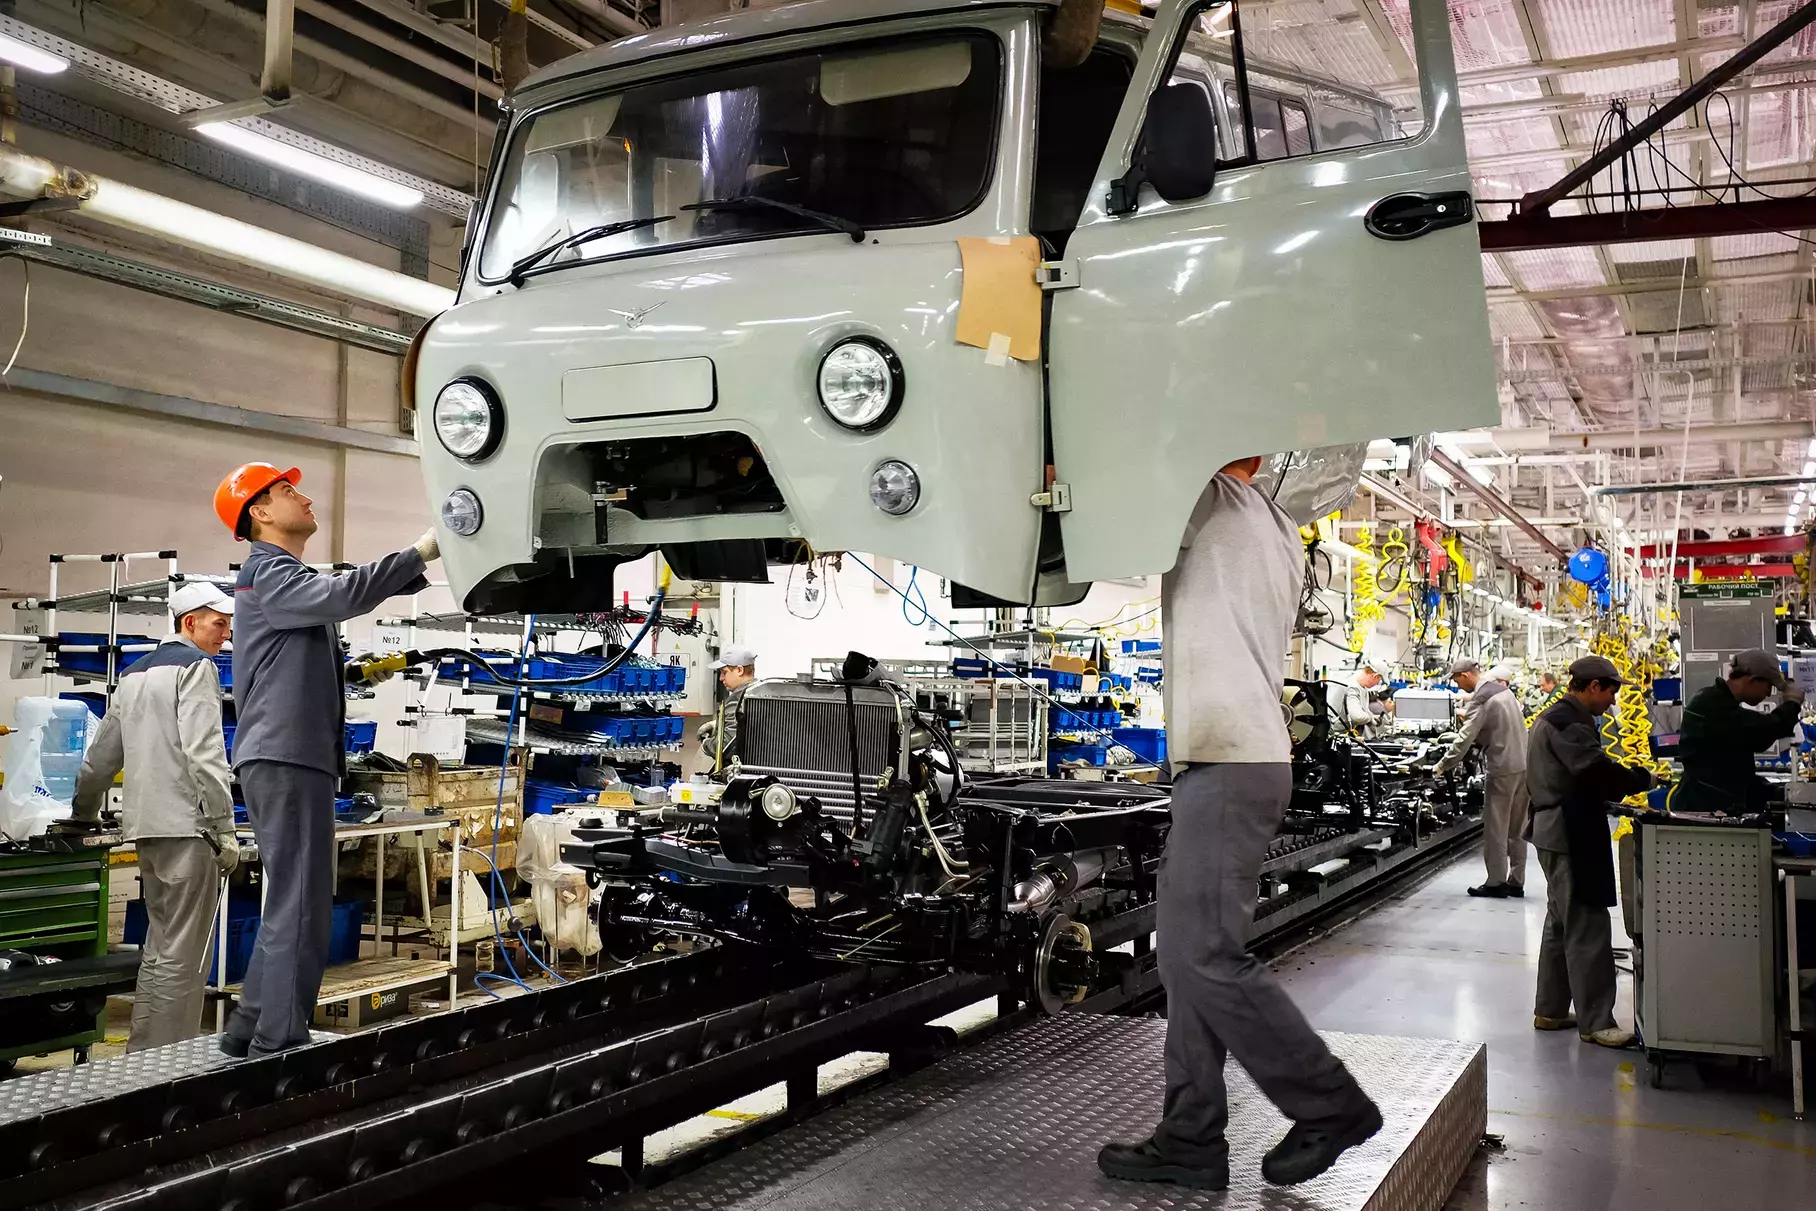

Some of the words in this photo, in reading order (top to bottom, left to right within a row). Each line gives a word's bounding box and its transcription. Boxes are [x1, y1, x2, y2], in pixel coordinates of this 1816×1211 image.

[23, 624, 39, 634] №12
[382, 635, 401, 645] №12
[21, 660, 34, 670] №1
